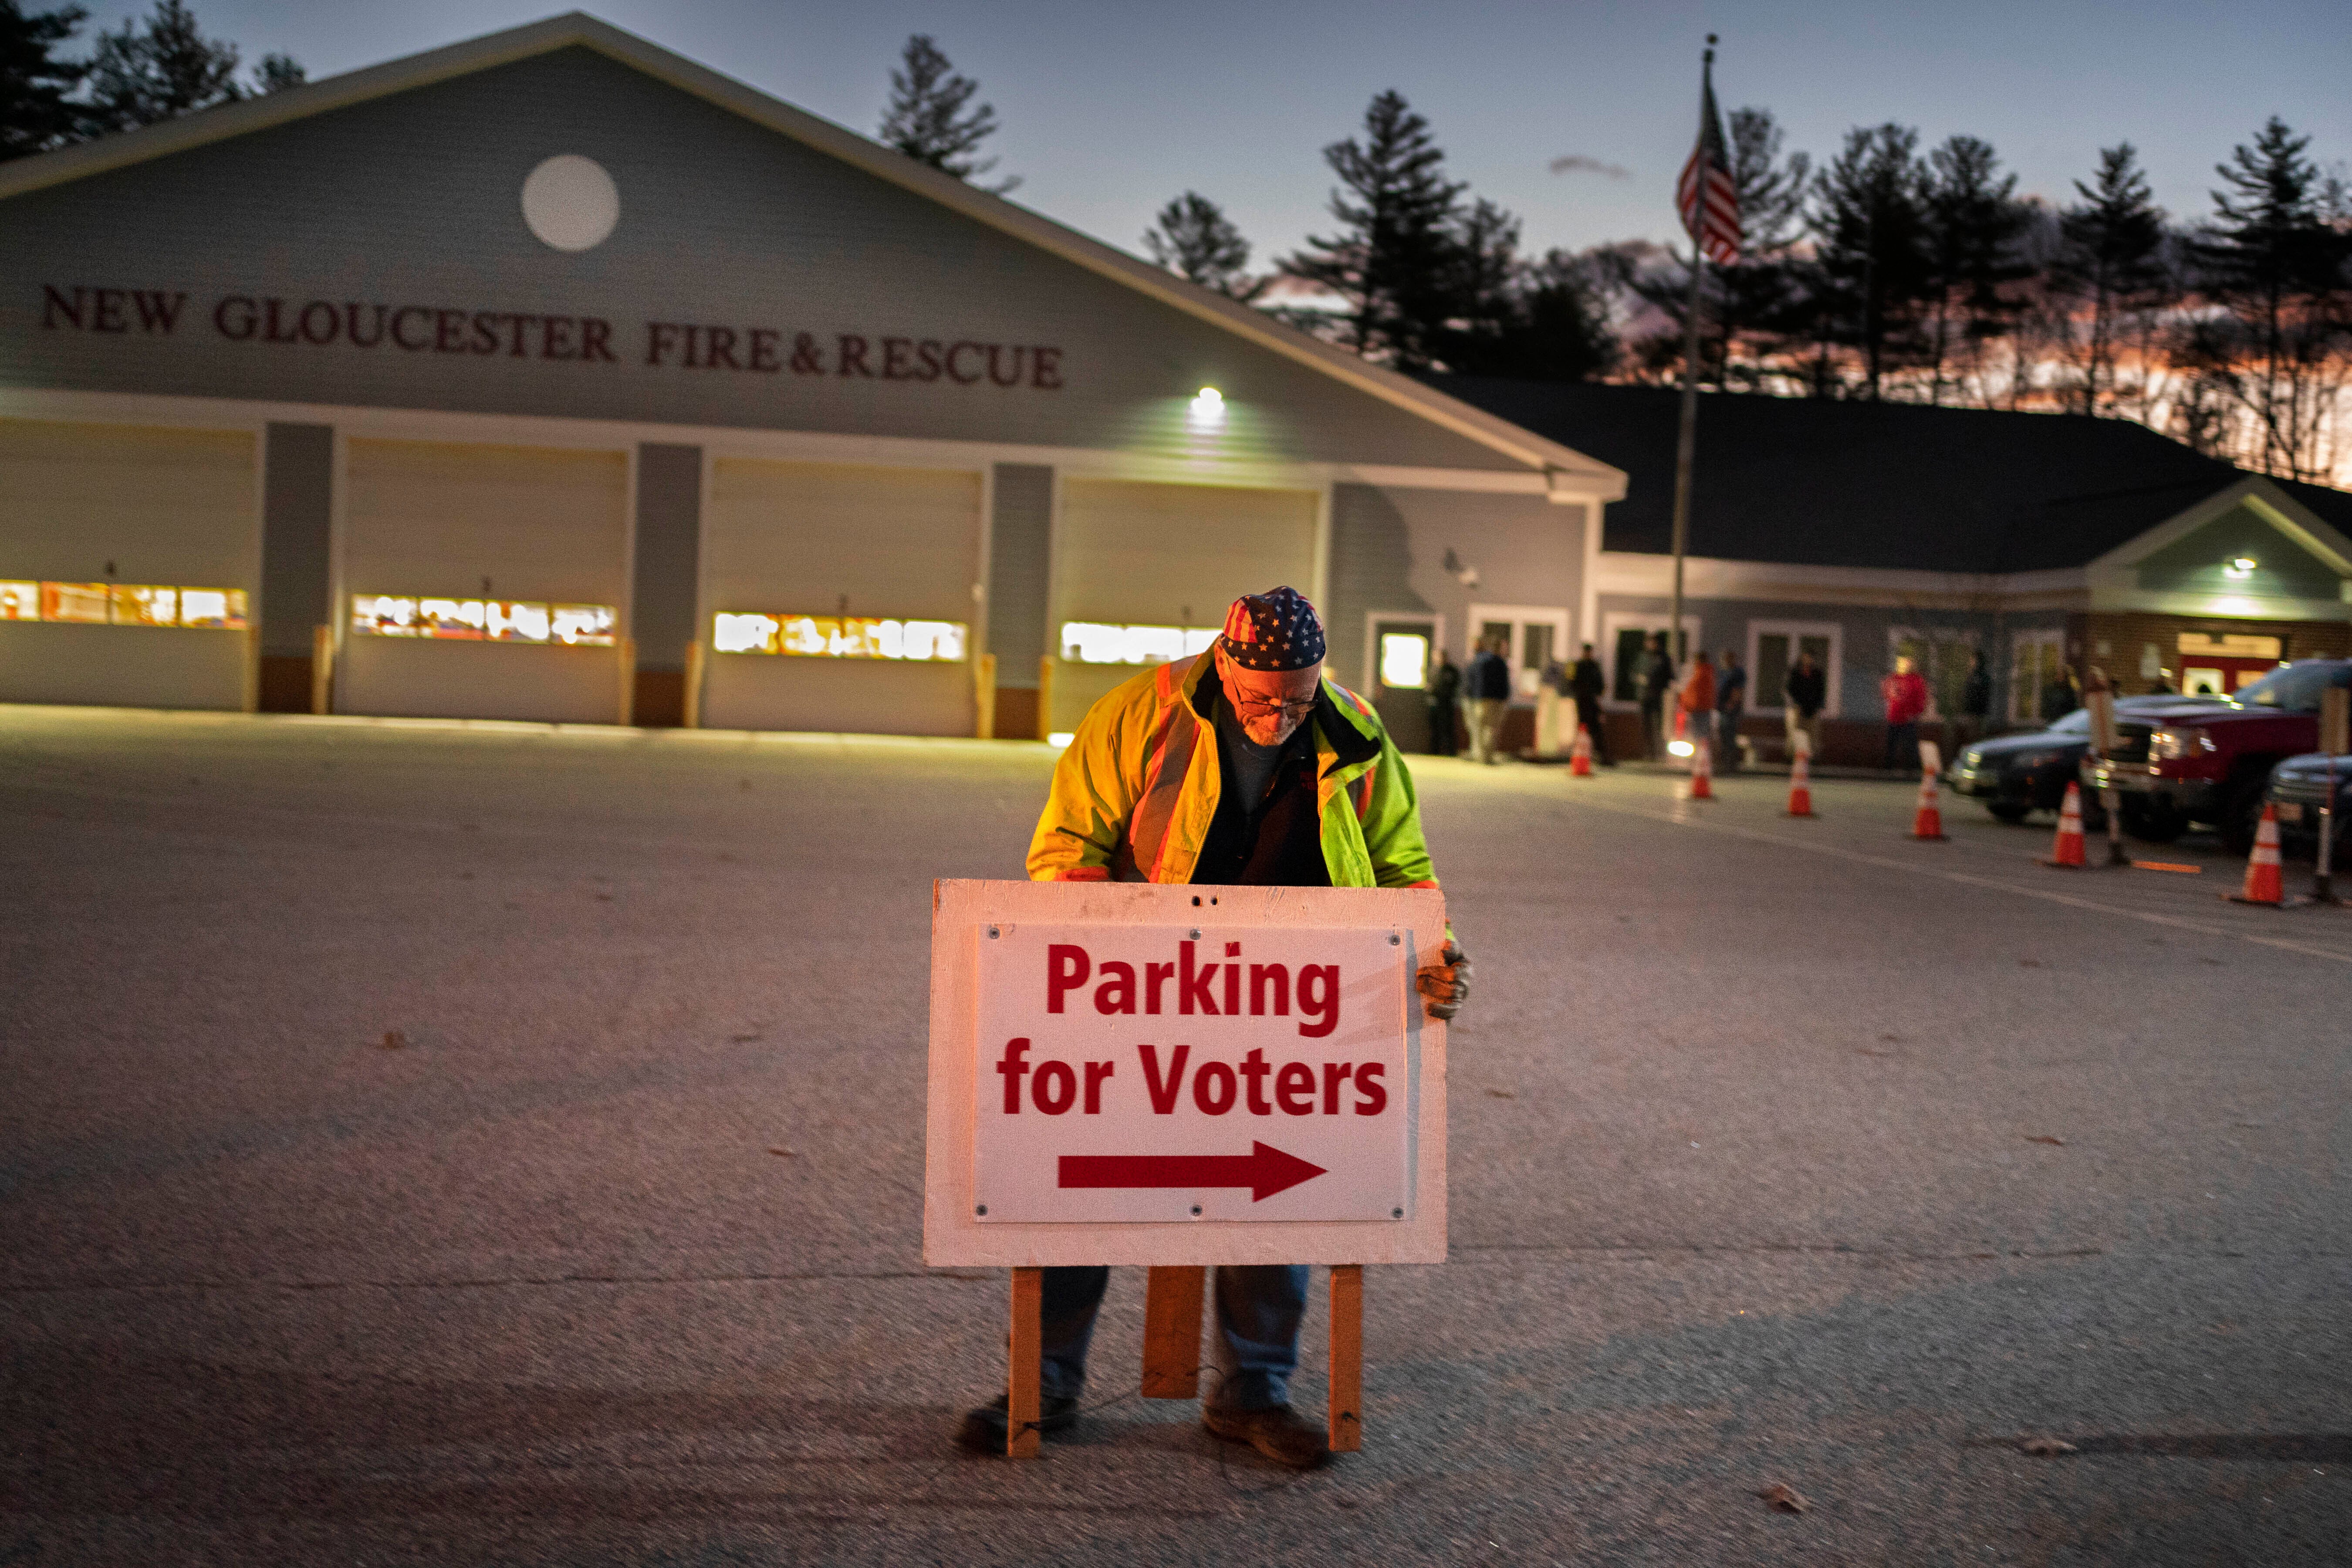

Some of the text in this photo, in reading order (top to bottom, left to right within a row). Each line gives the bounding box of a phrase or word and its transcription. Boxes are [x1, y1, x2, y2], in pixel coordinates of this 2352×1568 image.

[42, 284, 186, 335] NEW
[212, 295, 616, 364] GLOUCESTER
[1047, 940, 1340, 1038] Parking
[996, 1037, 1387, 1116] for Voters
